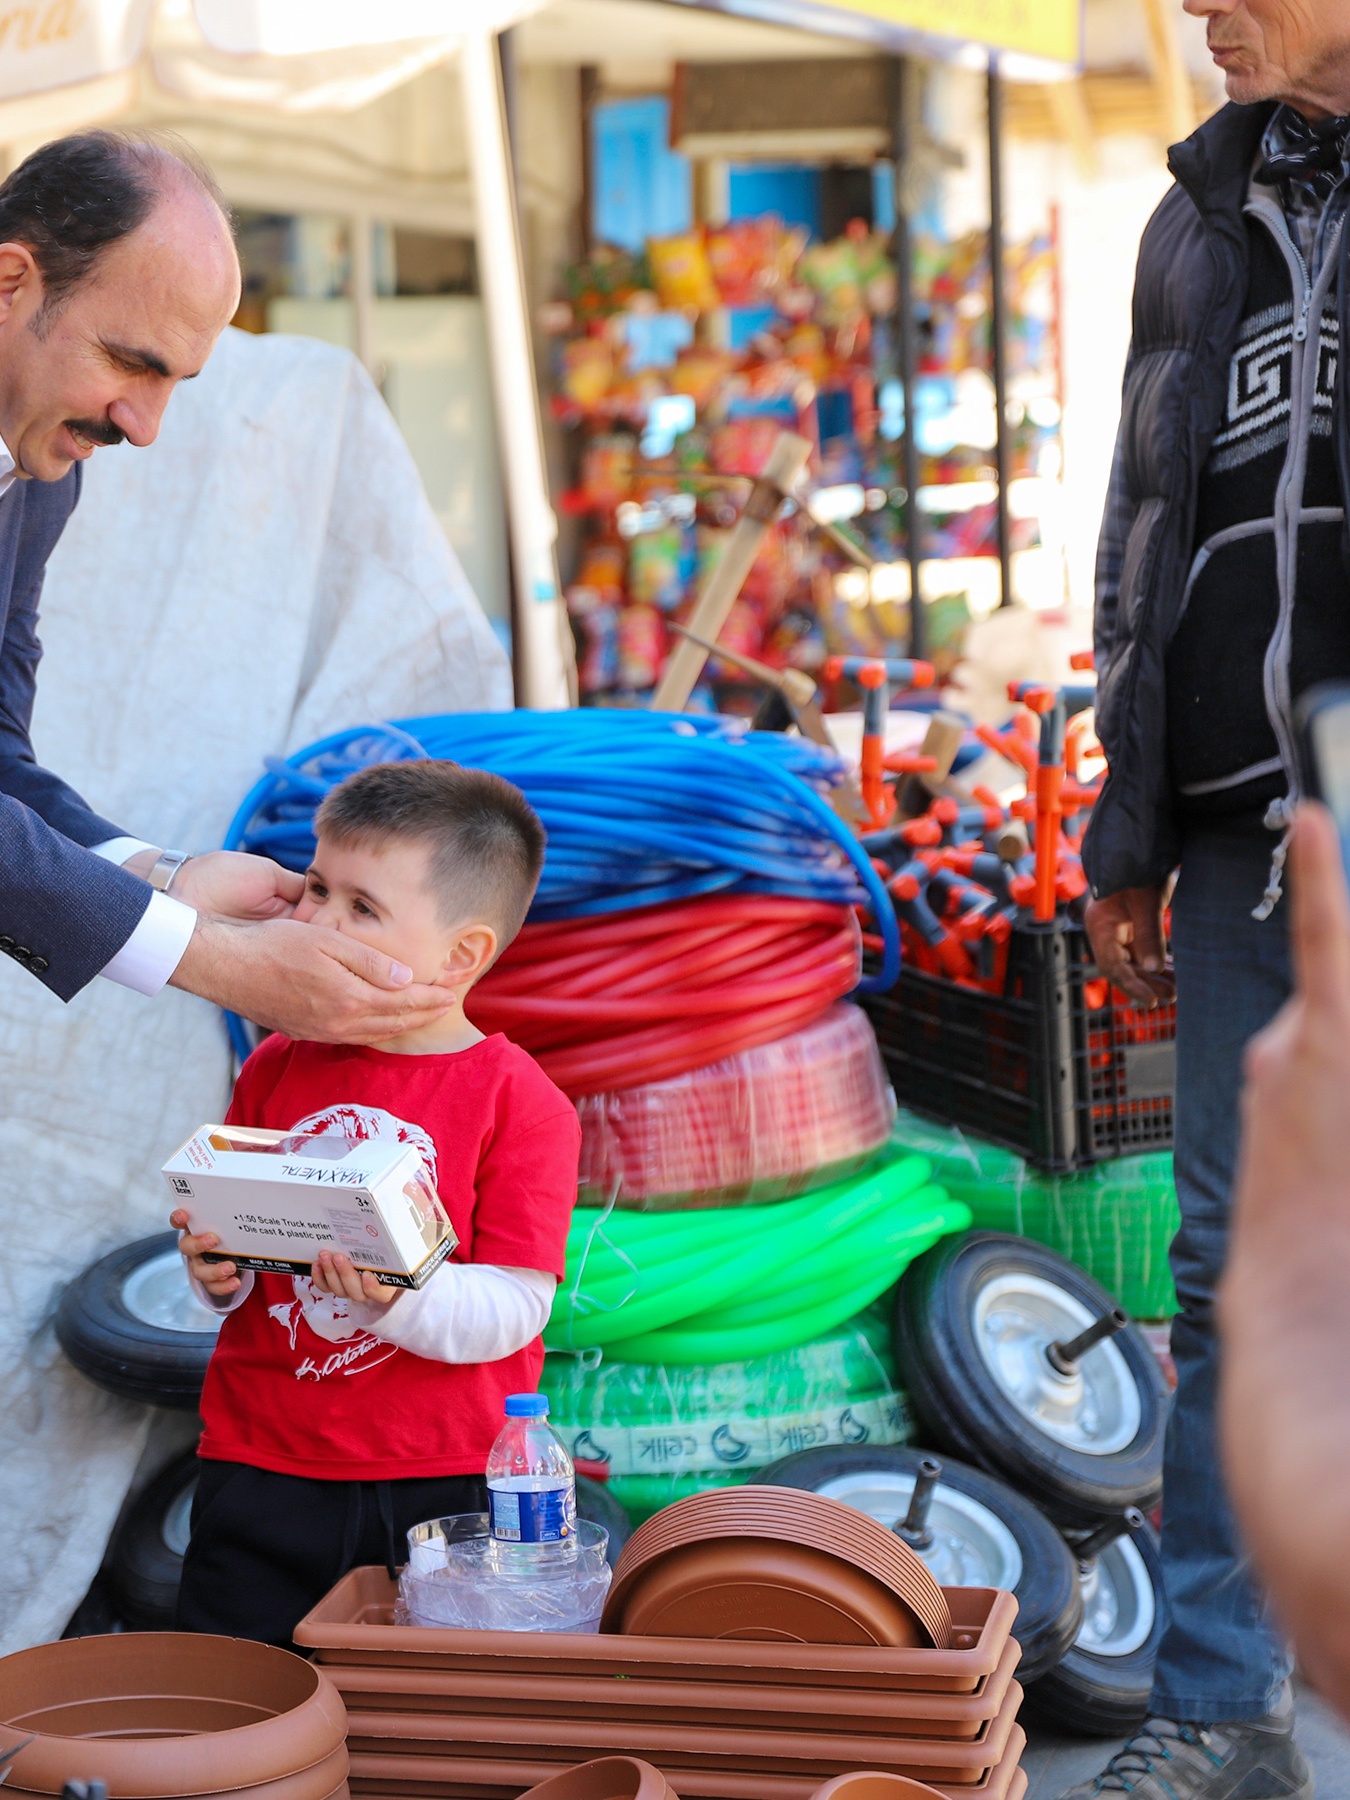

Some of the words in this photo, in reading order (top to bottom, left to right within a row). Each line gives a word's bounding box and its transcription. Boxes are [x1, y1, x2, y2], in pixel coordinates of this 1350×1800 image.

[355, 1196, 369, 1207] 3+
[239, 1214, 256, 1223] 1:50
[258, 1215, 281, 1226] Scale
[281, 1218, 306, 1228] Truck
[243, 1224, 258, 1234] Die
[259, 1228, 277, 1236] cast
[278, 1228, 285, 1236] &
[286, 1229, 315, 1239] plastic
[316, 1232, 335, 1241] part
